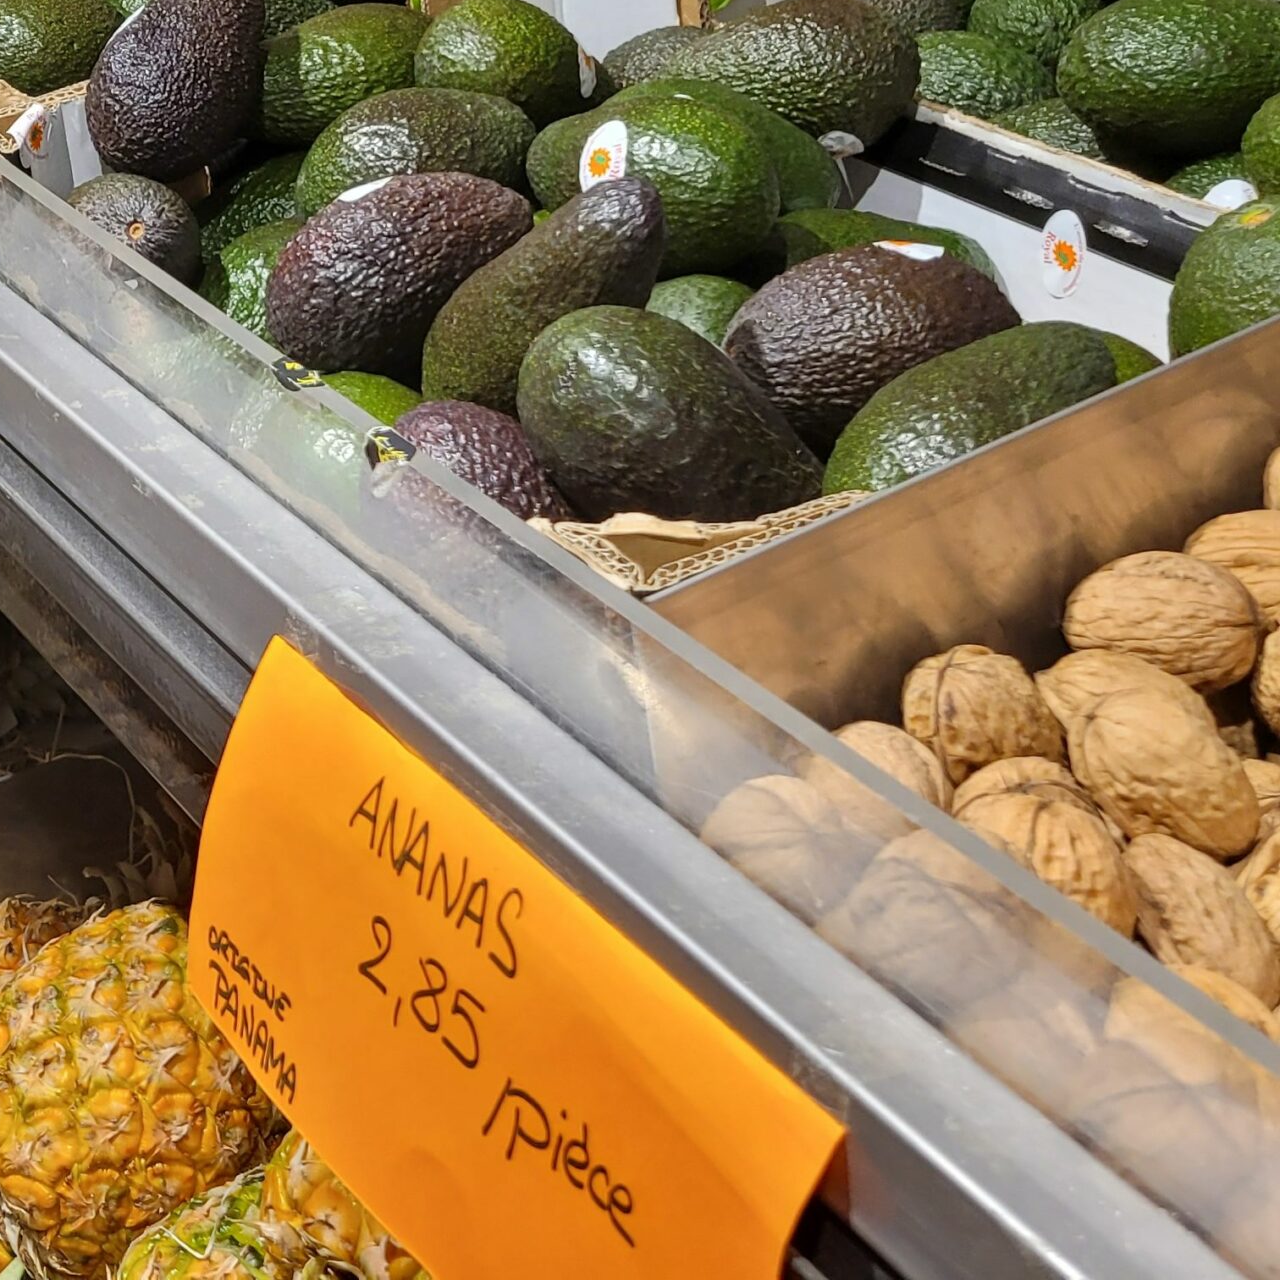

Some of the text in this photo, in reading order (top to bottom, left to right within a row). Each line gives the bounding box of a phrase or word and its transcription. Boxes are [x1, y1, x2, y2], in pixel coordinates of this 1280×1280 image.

[1043, 231, 1057, 264] Royal
[349, 776, 524, 978] ANANAS
[208, 925, 292, 1022] ORIGINE
[209, 959, 297, 1104] PANAMA
[357, 915, 488, 1068] 2,85
